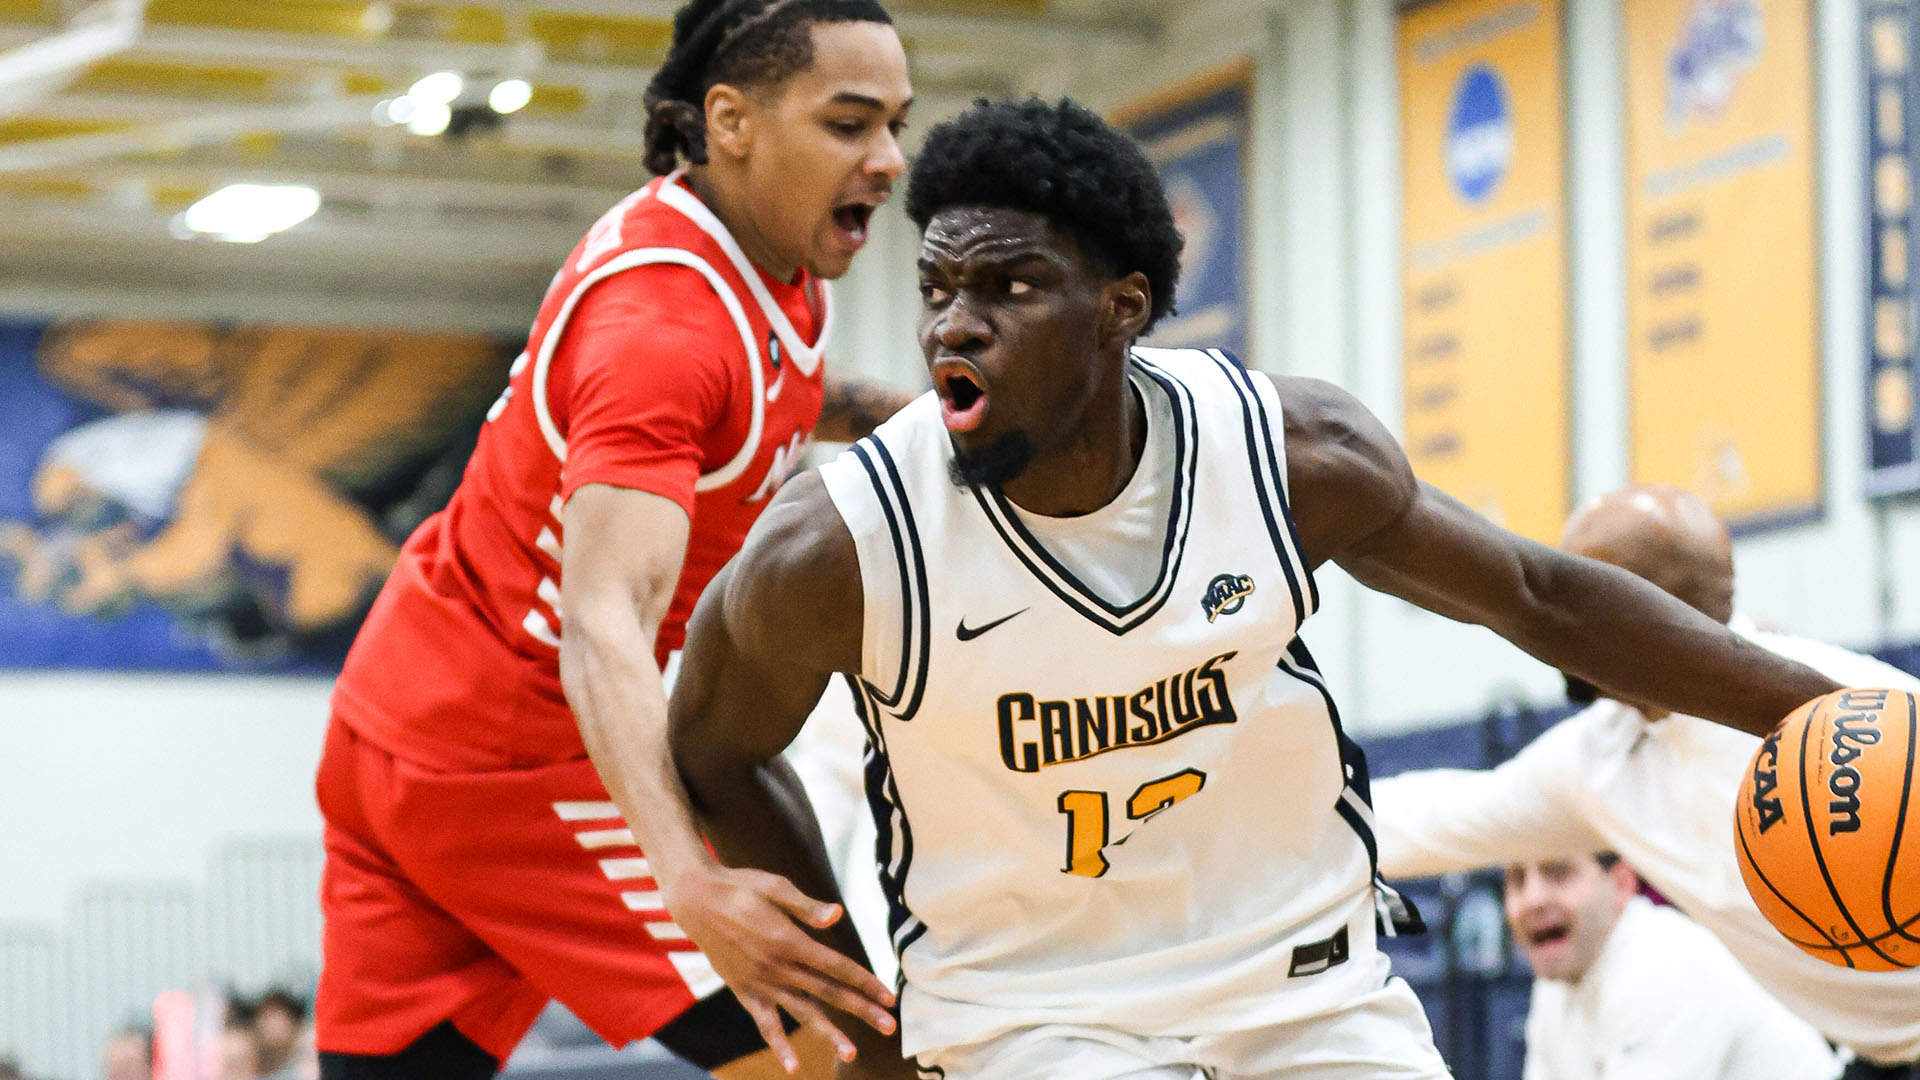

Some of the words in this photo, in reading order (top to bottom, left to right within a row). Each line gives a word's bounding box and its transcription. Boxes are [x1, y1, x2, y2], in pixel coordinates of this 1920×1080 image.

[1201, 574, 1255, 623] MAAC
[997, 650, 1238, 772] CANISIUS
[1829, 689, 1887, 836] Wilson
